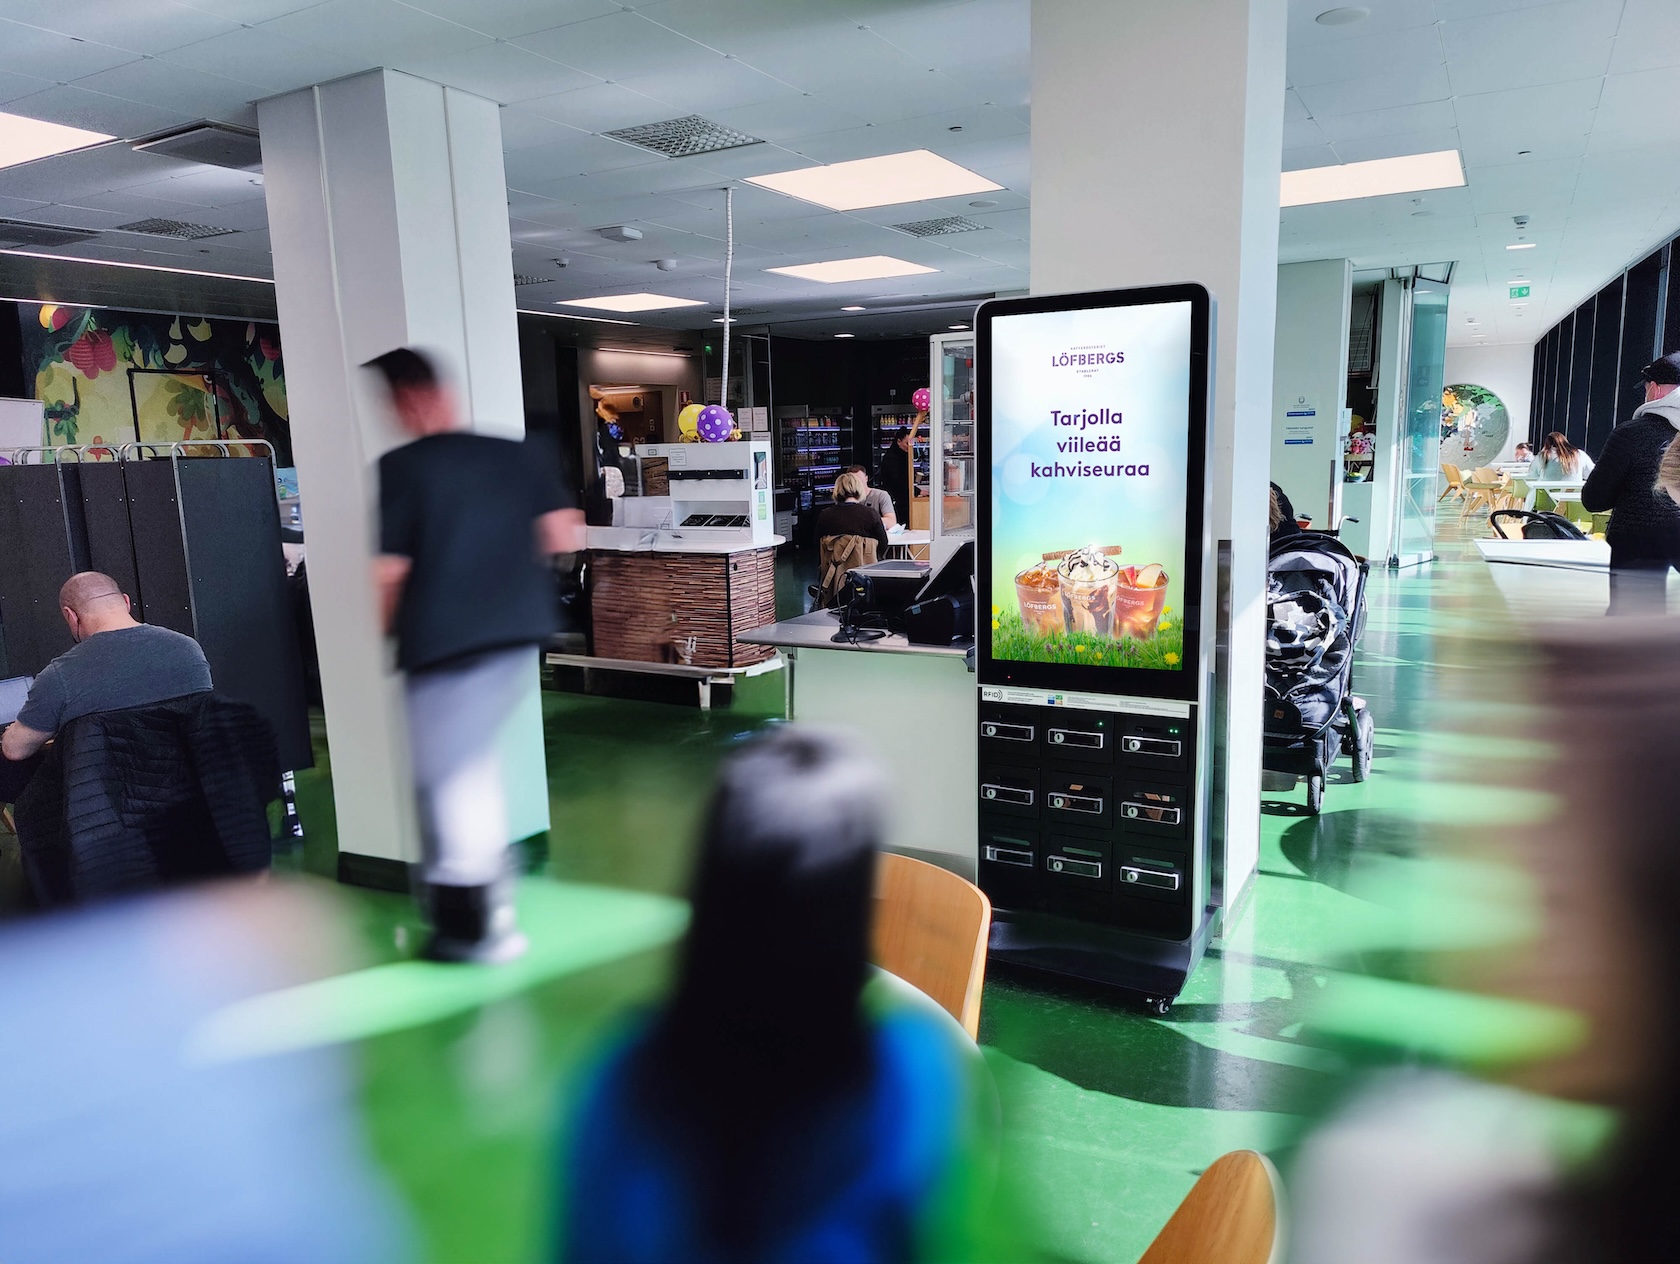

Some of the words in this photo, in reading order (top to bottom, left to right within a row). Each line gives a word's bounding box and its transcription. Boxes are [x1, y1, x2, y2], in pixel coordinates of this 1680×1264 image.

[1052, 351, 1125, 367] LÖFBERGS
[1050, 408, 1122, 430] Tarjolla
[1056, 435, 1121, 453] viileää
[1031, 460, 1150, 478] kahviseuraa
